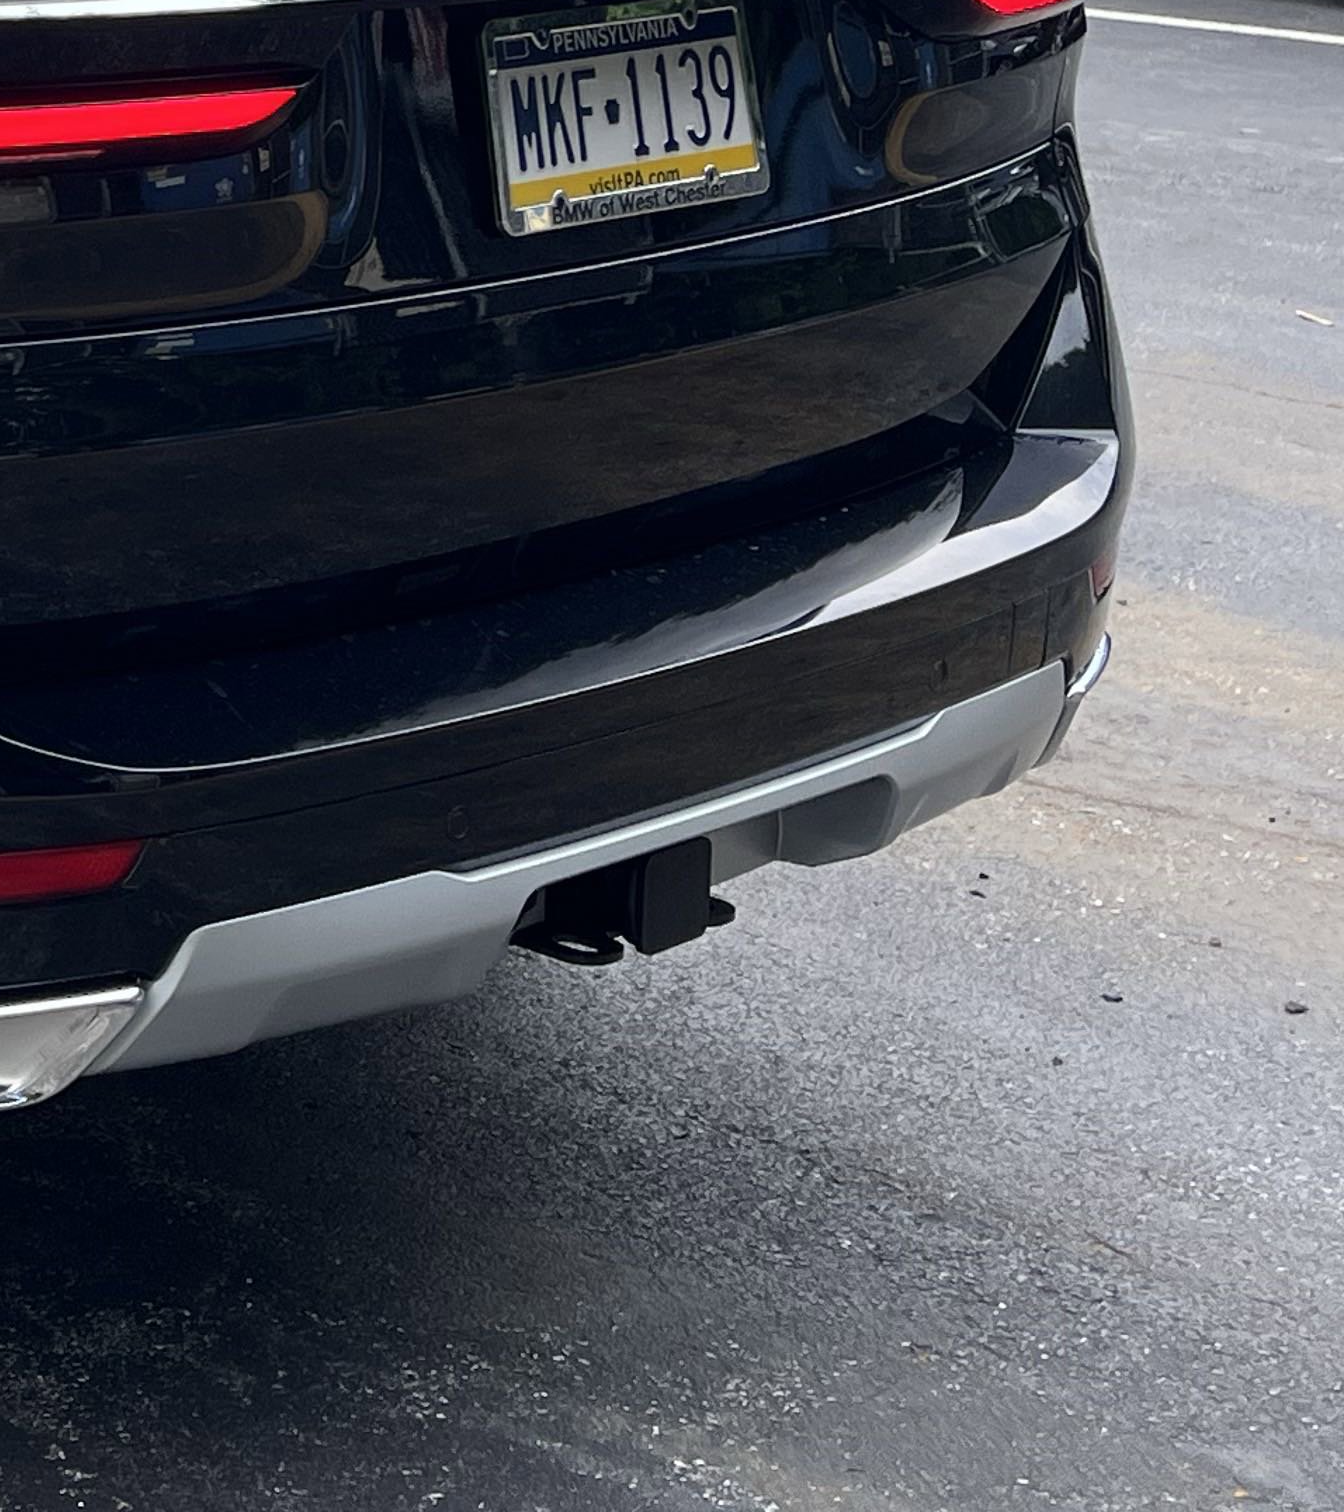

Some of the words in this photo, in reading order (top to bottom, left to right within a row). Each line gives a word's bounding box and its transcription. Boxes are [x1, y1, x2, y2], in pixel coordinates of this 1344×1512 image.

[552, 17, 679, 54] PENNSYLVANIA
[511, 68, 596, 172] MKF
[626, 45, 735, 156] 1139
[552, 199, 593, 225] BMW
[599, 199, 618, 217] of
[619, 191, 659, 213] West
[664, 180, 725, 206] Chester
